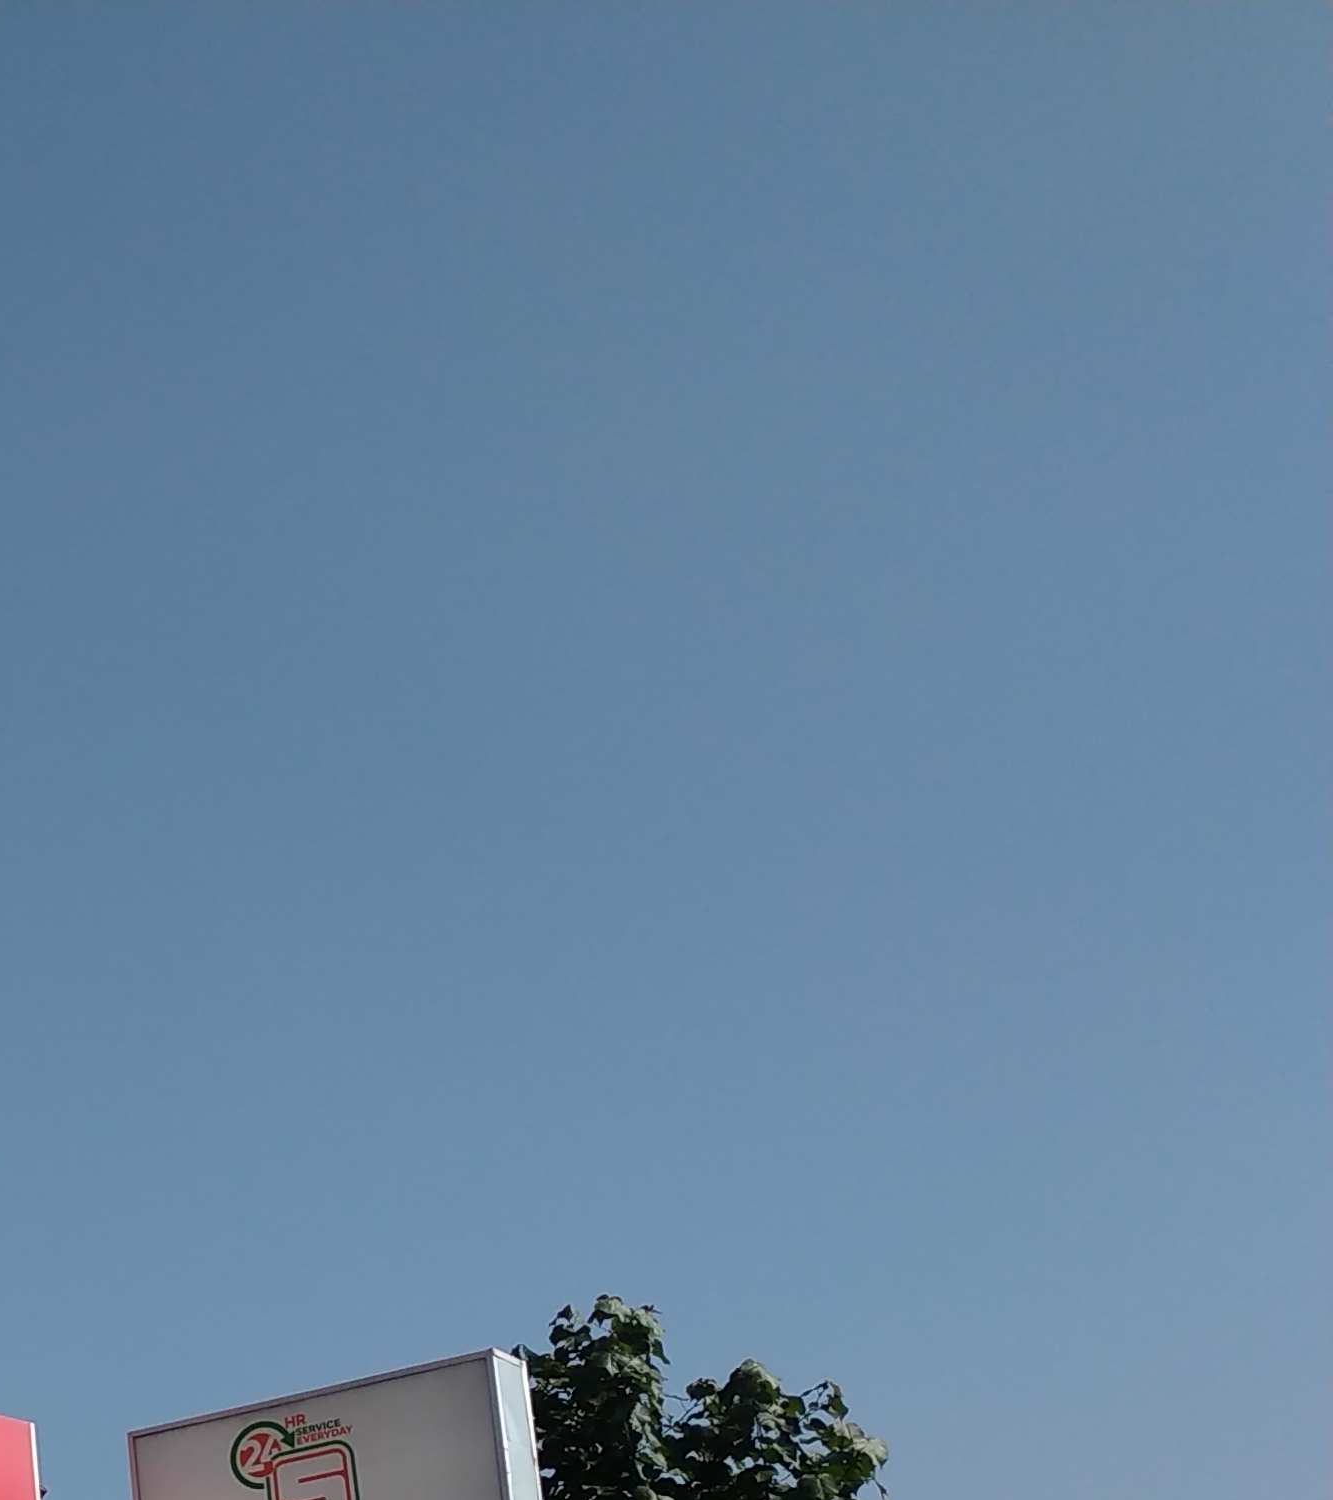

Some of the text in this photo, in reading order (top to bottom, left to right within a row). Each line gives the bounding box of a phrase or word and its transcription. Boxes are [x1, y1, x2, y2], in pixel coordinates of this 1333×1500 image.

[284, 1413, 306, 1429] HR
[295, 1417, 341, 1436] SERVICE
[296, 1424, 354, 1446] EVERYDAY
